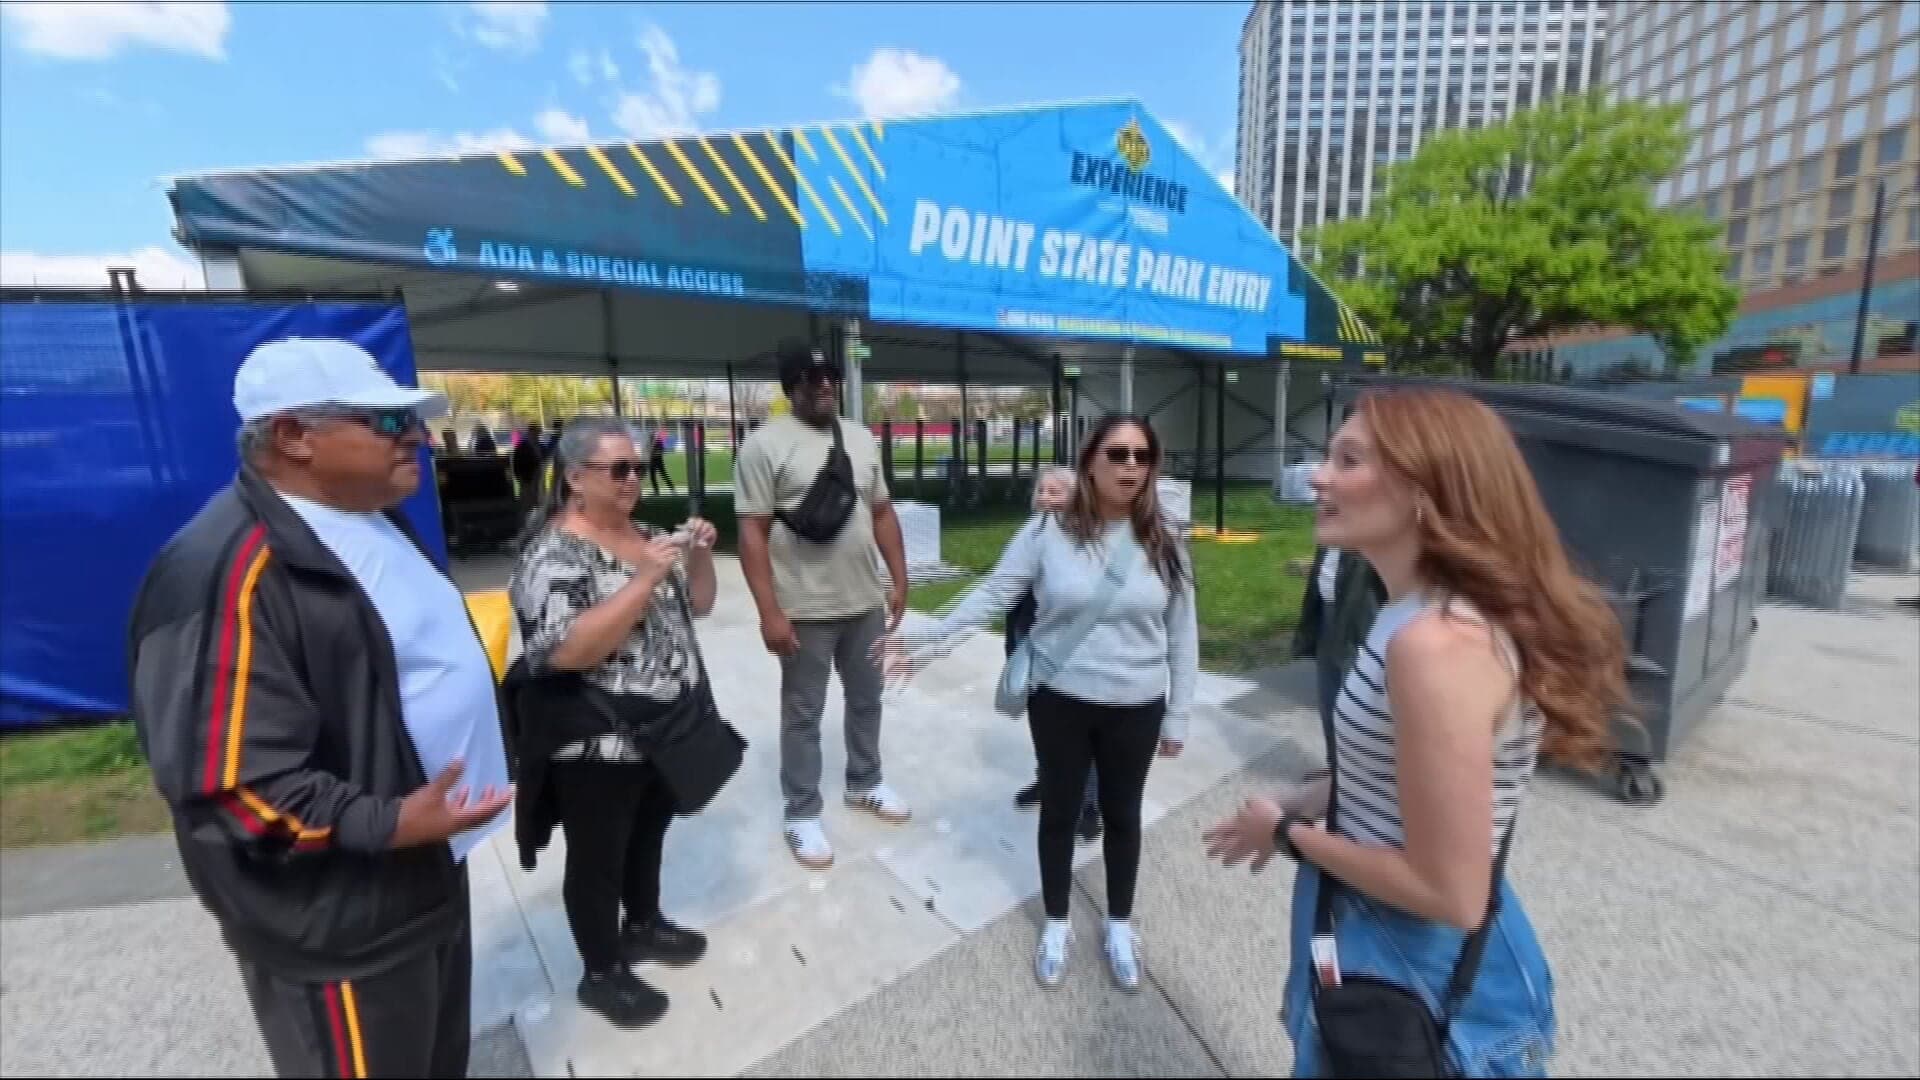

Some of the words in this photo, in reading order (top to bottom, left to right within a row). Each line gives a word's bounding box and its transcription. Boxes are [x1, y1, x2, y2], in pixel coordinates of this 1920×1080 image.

[1071, 151, 1188, 214] EXPERIENCE
[479, 240, 535, 270] ADA
[541, 249, 560, 273] &
[565, 251, 663, 288] SPECIAL
[666, 264, 745, 297] ACCESS
[910, 199, 1034, 271] POINT
[1039, 229, 1131, 287] STATE
[1135, 248, 1204, 300] PARK
[1206, 265, 1271, 312] ENTRY
